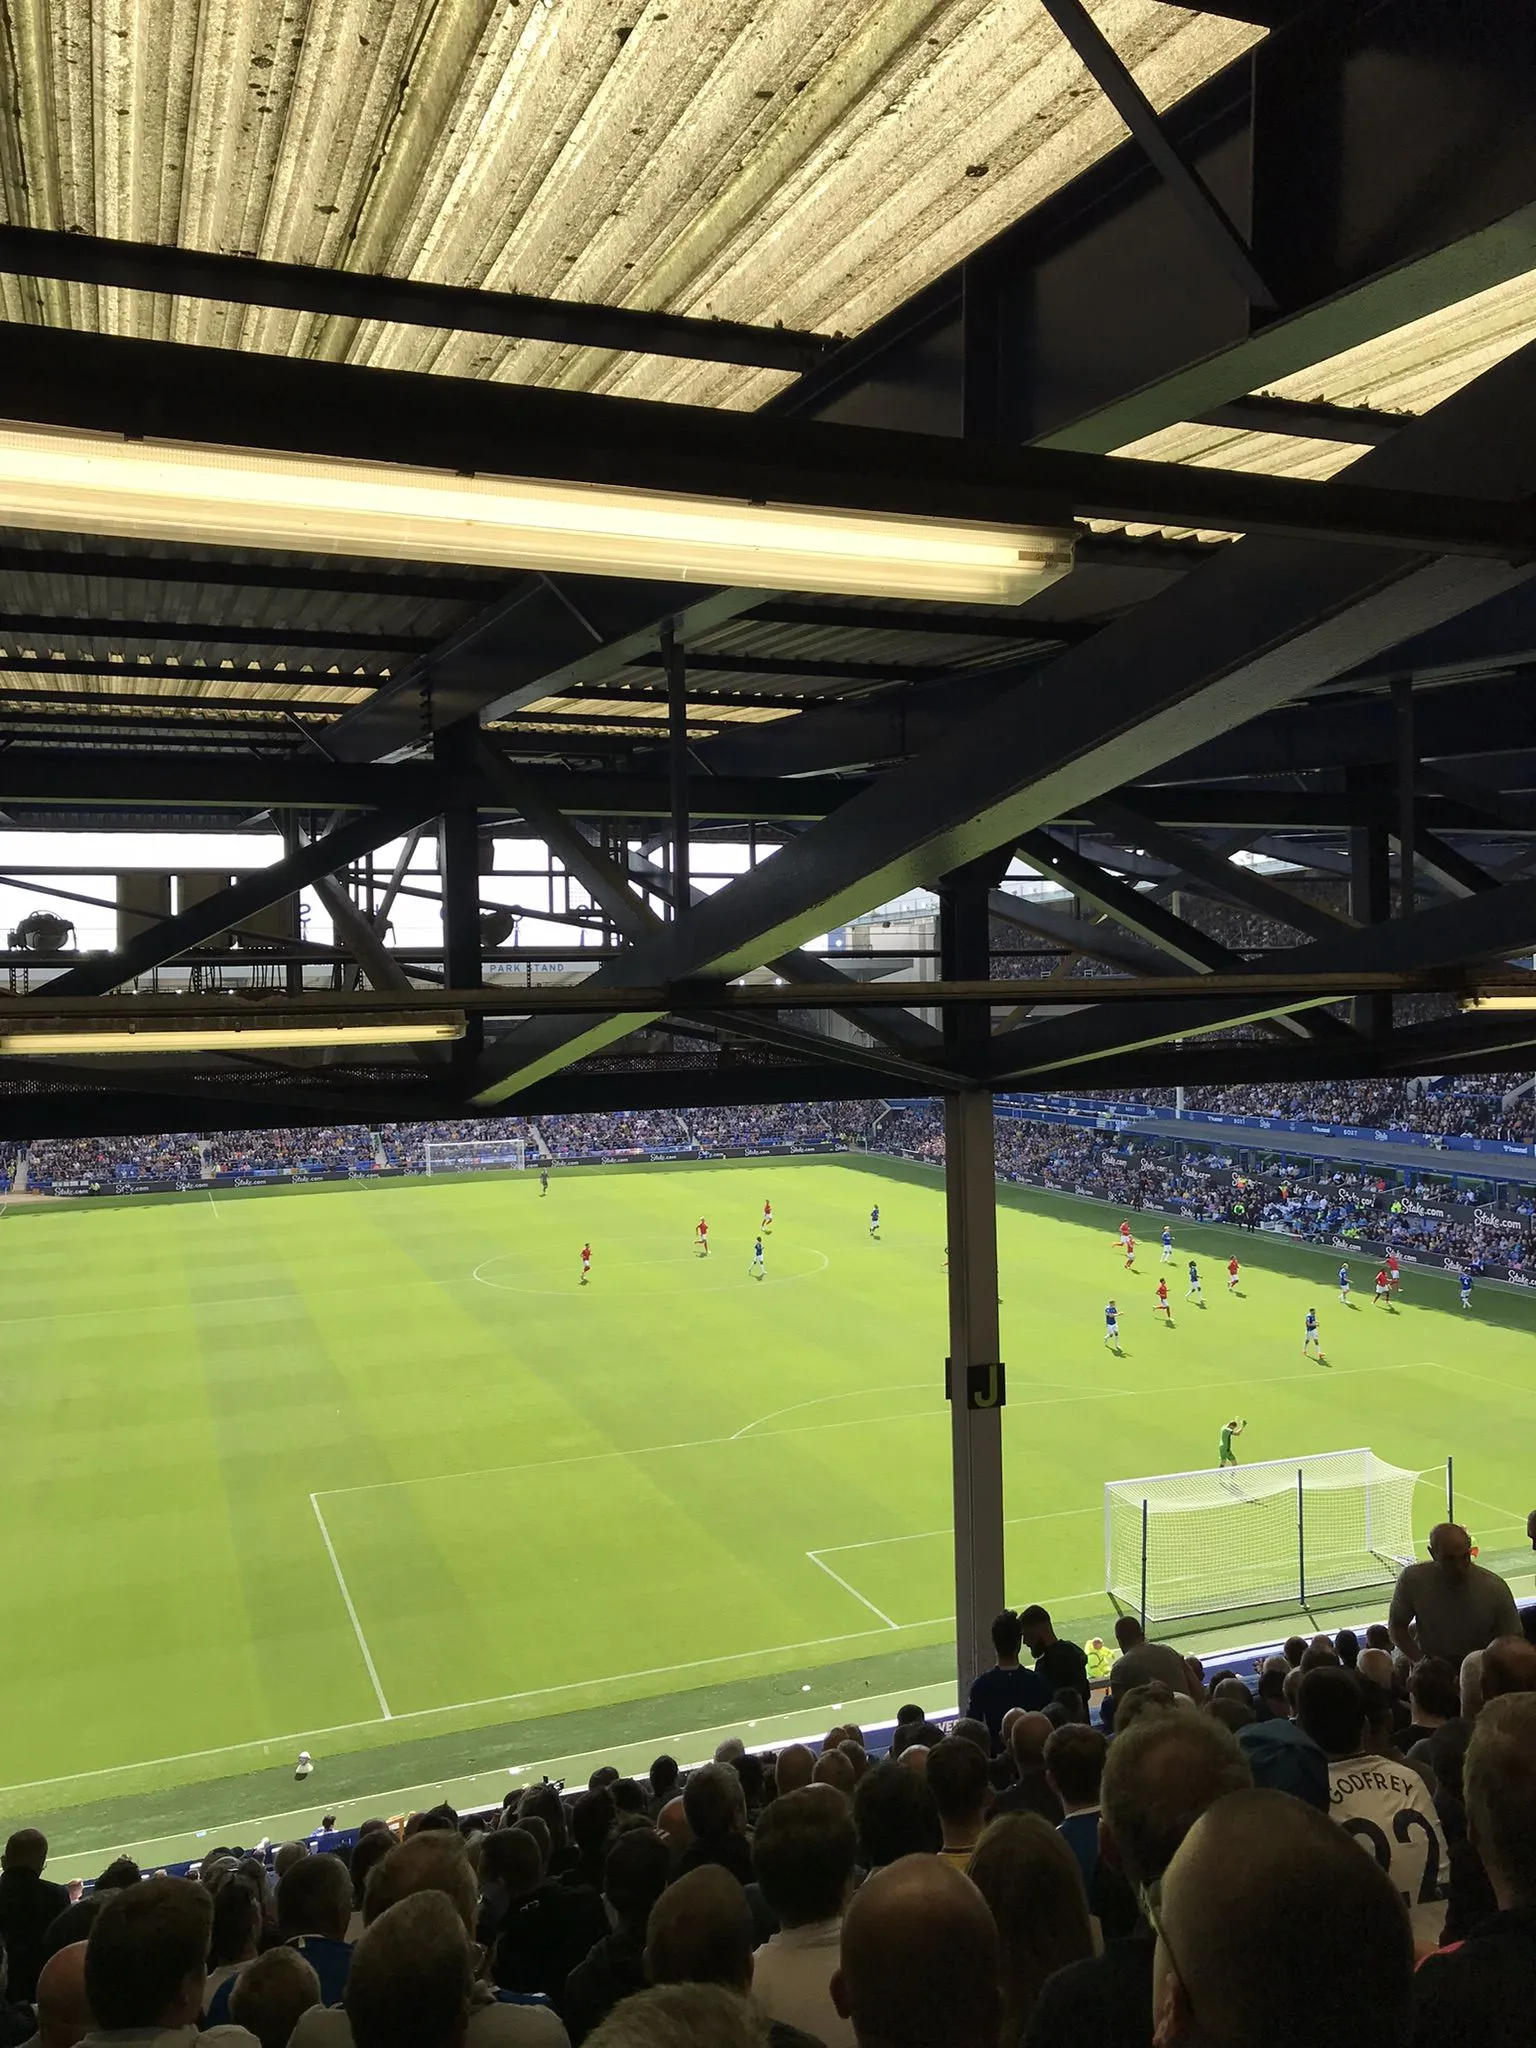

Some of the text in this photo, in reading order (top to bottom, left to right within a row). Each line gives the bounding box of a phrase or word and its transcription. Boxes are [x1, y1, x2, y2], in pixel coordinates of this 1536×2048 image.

[490, 964, 520, 972] PARK
[1401, 1198, 1444, 1217] Stake.com
[1474, 1208, 1521, 1230] Stake.com
[1332, 1235, 1361, 1251] Stake.com
[974, 1365, 998, 1407] J
[1329, 1772, 1414, 1805] GODFREY
